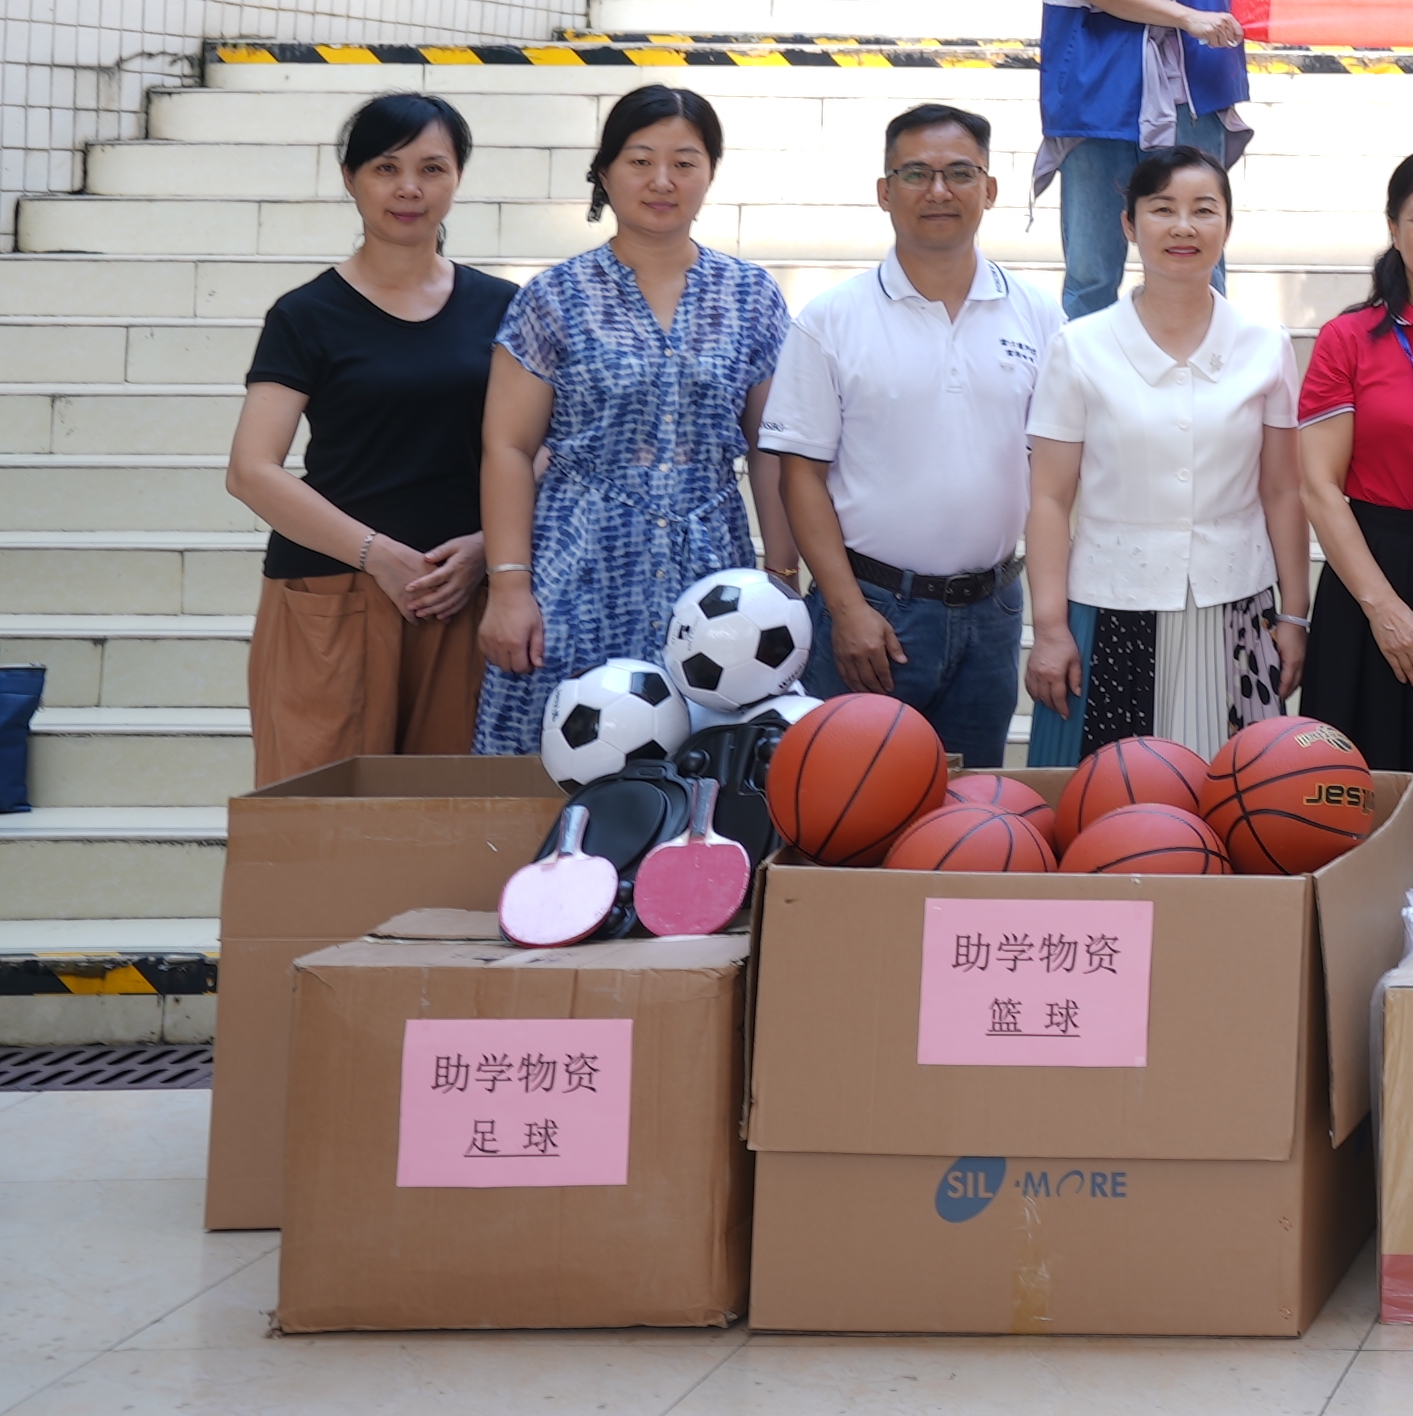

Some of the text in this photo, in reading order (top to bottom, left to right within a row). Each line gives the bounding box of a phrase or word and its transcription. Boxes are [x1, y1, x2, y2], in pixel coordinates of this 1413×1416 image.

[951, 932, 1121, 975] 助学物资
[430, 1052, 601, 1094] 助学物资
[946, 1171, 995, 1199] SIL
